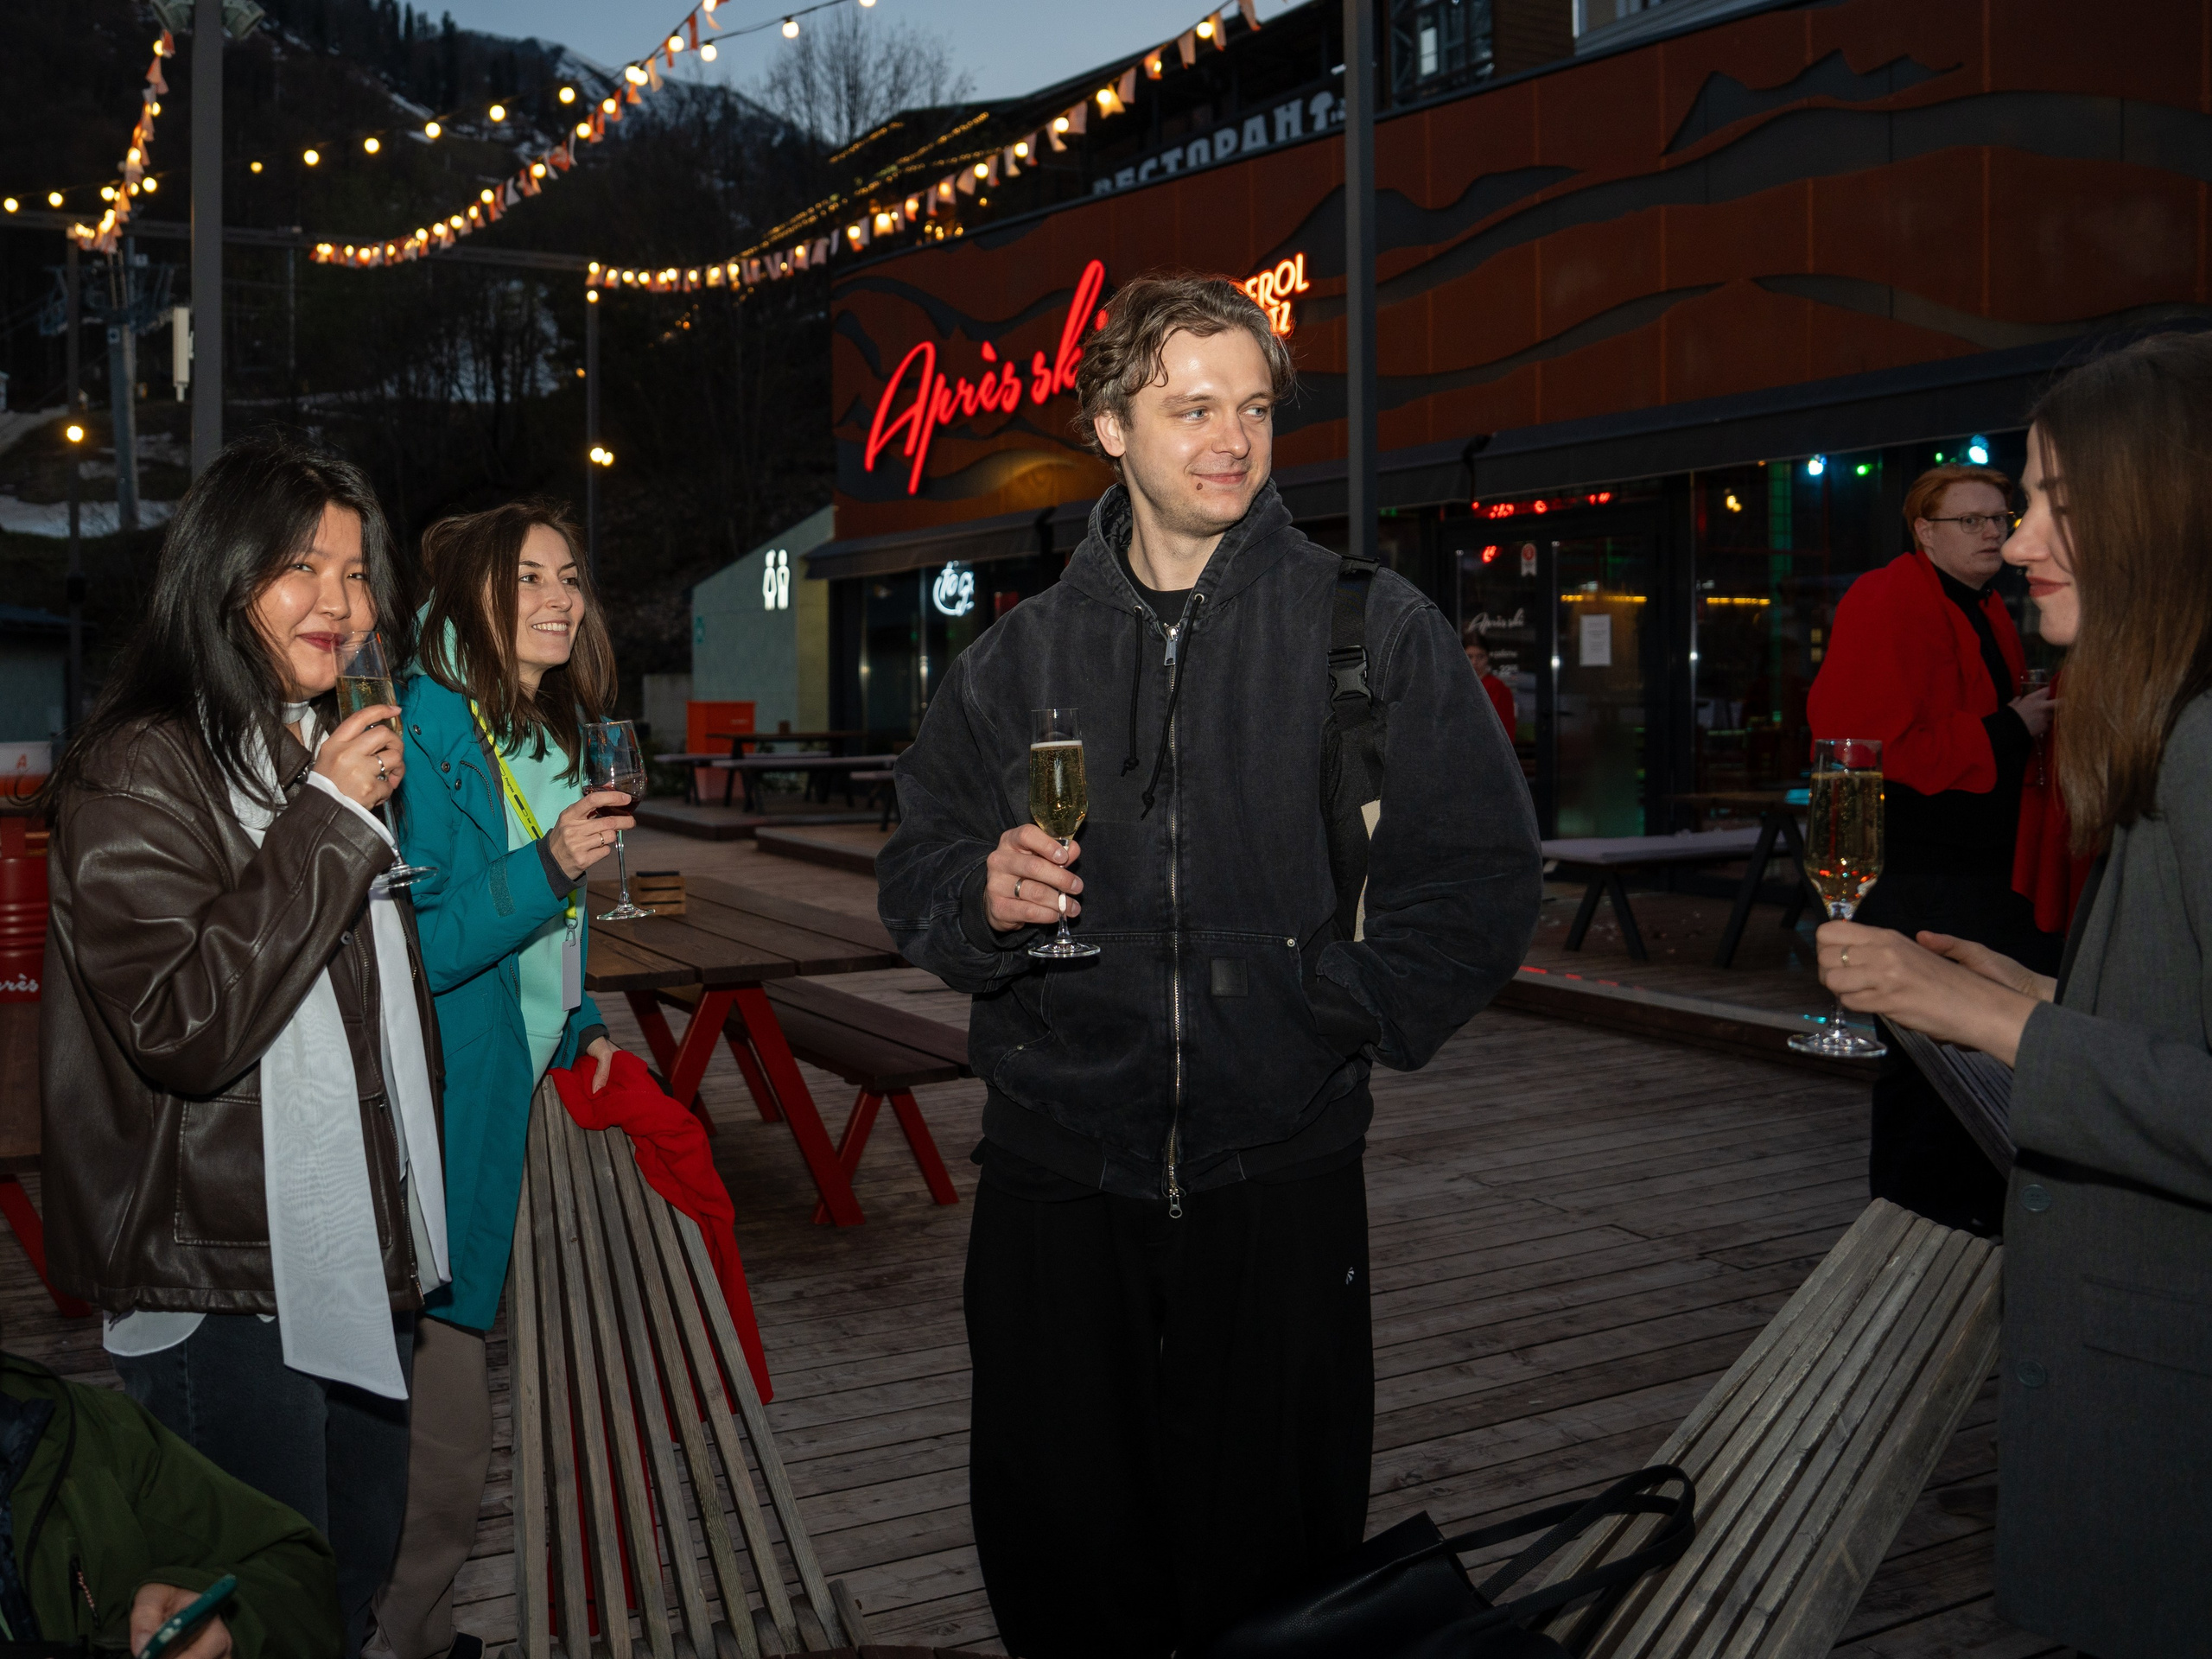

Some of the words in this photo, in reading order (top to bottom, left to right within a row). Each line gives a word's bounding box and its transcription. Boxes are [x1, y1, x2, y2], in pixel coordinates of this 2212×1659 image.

[1244, 252, 1310, 308] EROL
[865, 340, 1021, 495] Après
[0, 973, 39, 993] rès
